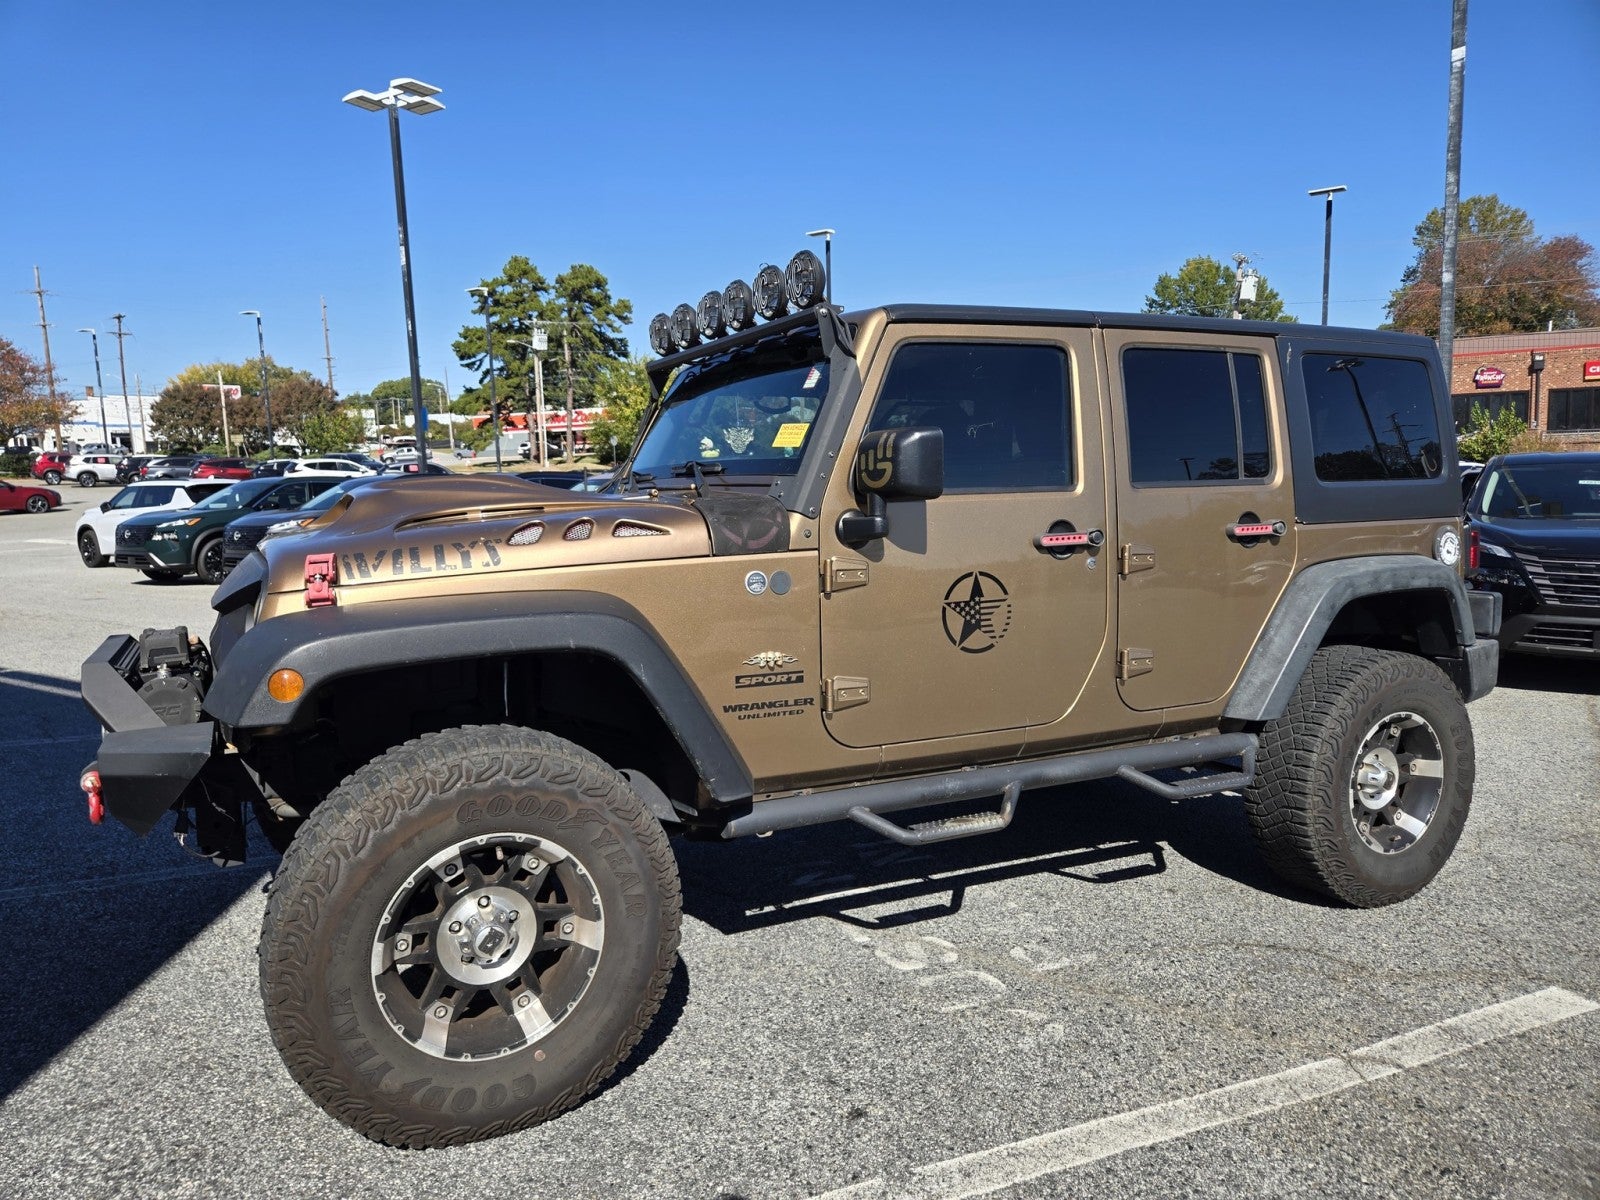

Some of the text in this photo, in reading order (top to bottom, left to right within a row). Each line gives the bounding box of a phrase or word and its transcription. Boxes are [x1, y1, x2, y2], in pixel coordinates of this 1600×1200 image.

[341, 538, 503, 580] WILLYS
[738, 673, 800, 686] SPORT
[722, 697, 814, 712] WRANGLER
[737, 709, 805, 721] UNLIMITED
